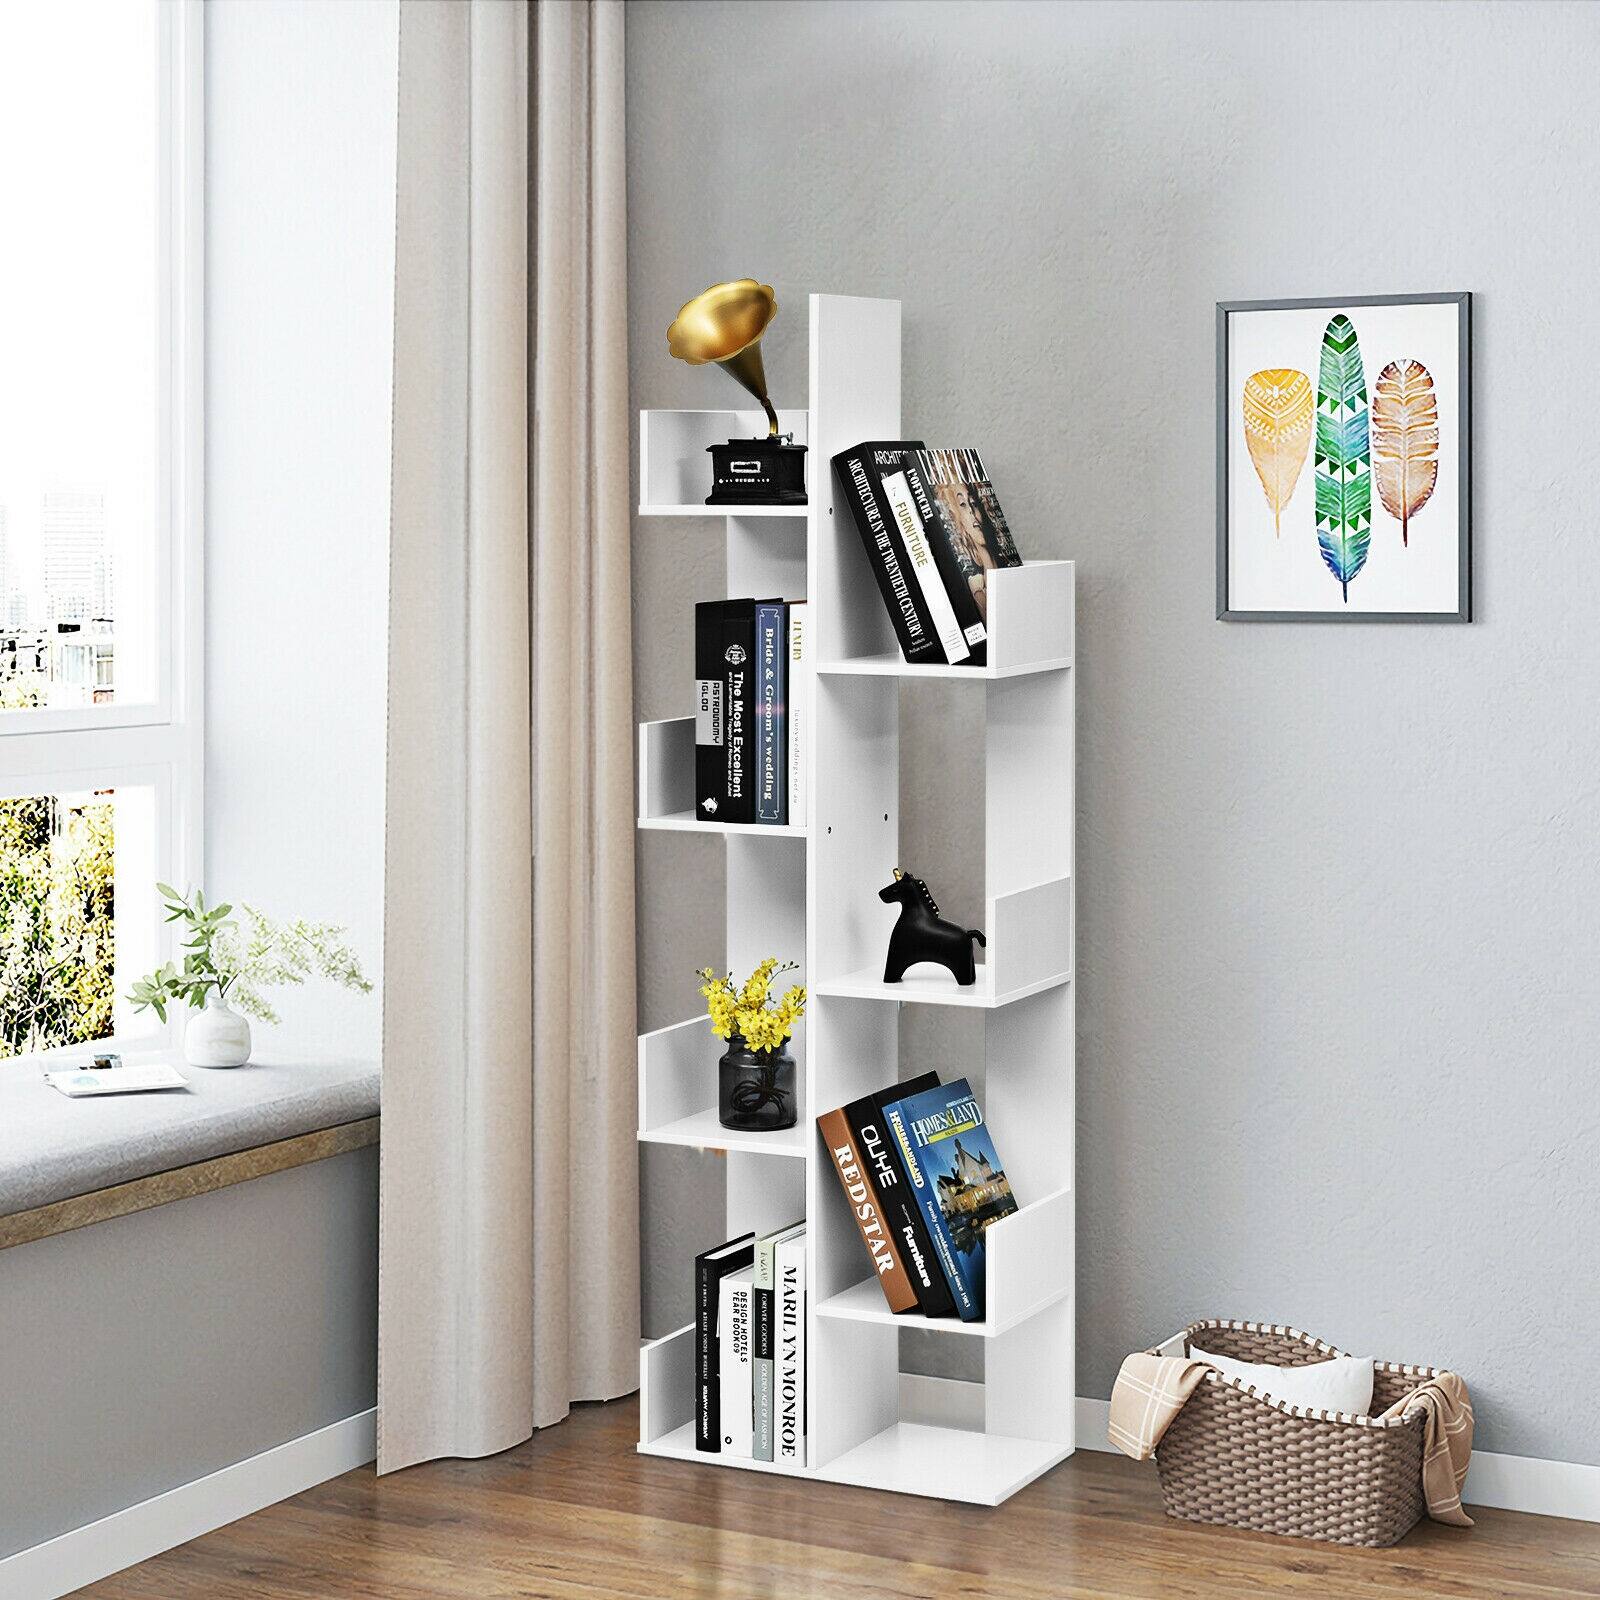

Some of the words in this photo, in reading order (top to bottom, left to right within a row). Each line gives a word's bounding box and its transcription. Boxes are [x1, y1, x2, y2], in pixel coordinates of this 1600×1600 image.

[907, 467, 934, 523] L'OFFICIEL
[870, 519, 886, 533] IN
[874, 530, 892, 551] THE
[895, 501, 928, 568] FURNITURE
[881, 547, 911, 600] TWENTIETH
[899, 597, 925, 638] CENTURY
[765, 628, 774, 665] Bride
[733, 671, 744, 697] The
[765, 667, 774, 680] &
[701, 681, 709, 711] IGLOO
[765, 684, 774, 743] Groom's
[733, 700, 744, 733] Most
[733, 736, 744, 798] Excellent
[763, 746, 774, 800] wedding
[834, 1143, 895, 1275] REDSTAR
[902, 1225, 931, 1288] Furniture
[732, 1291, 740, 1315] YEAR
[740, 1291, 748, 1324] DESIGN
[740, 1327, 748, 1363] HOTELS
[782, 1366, 796, 1457] MONROE
